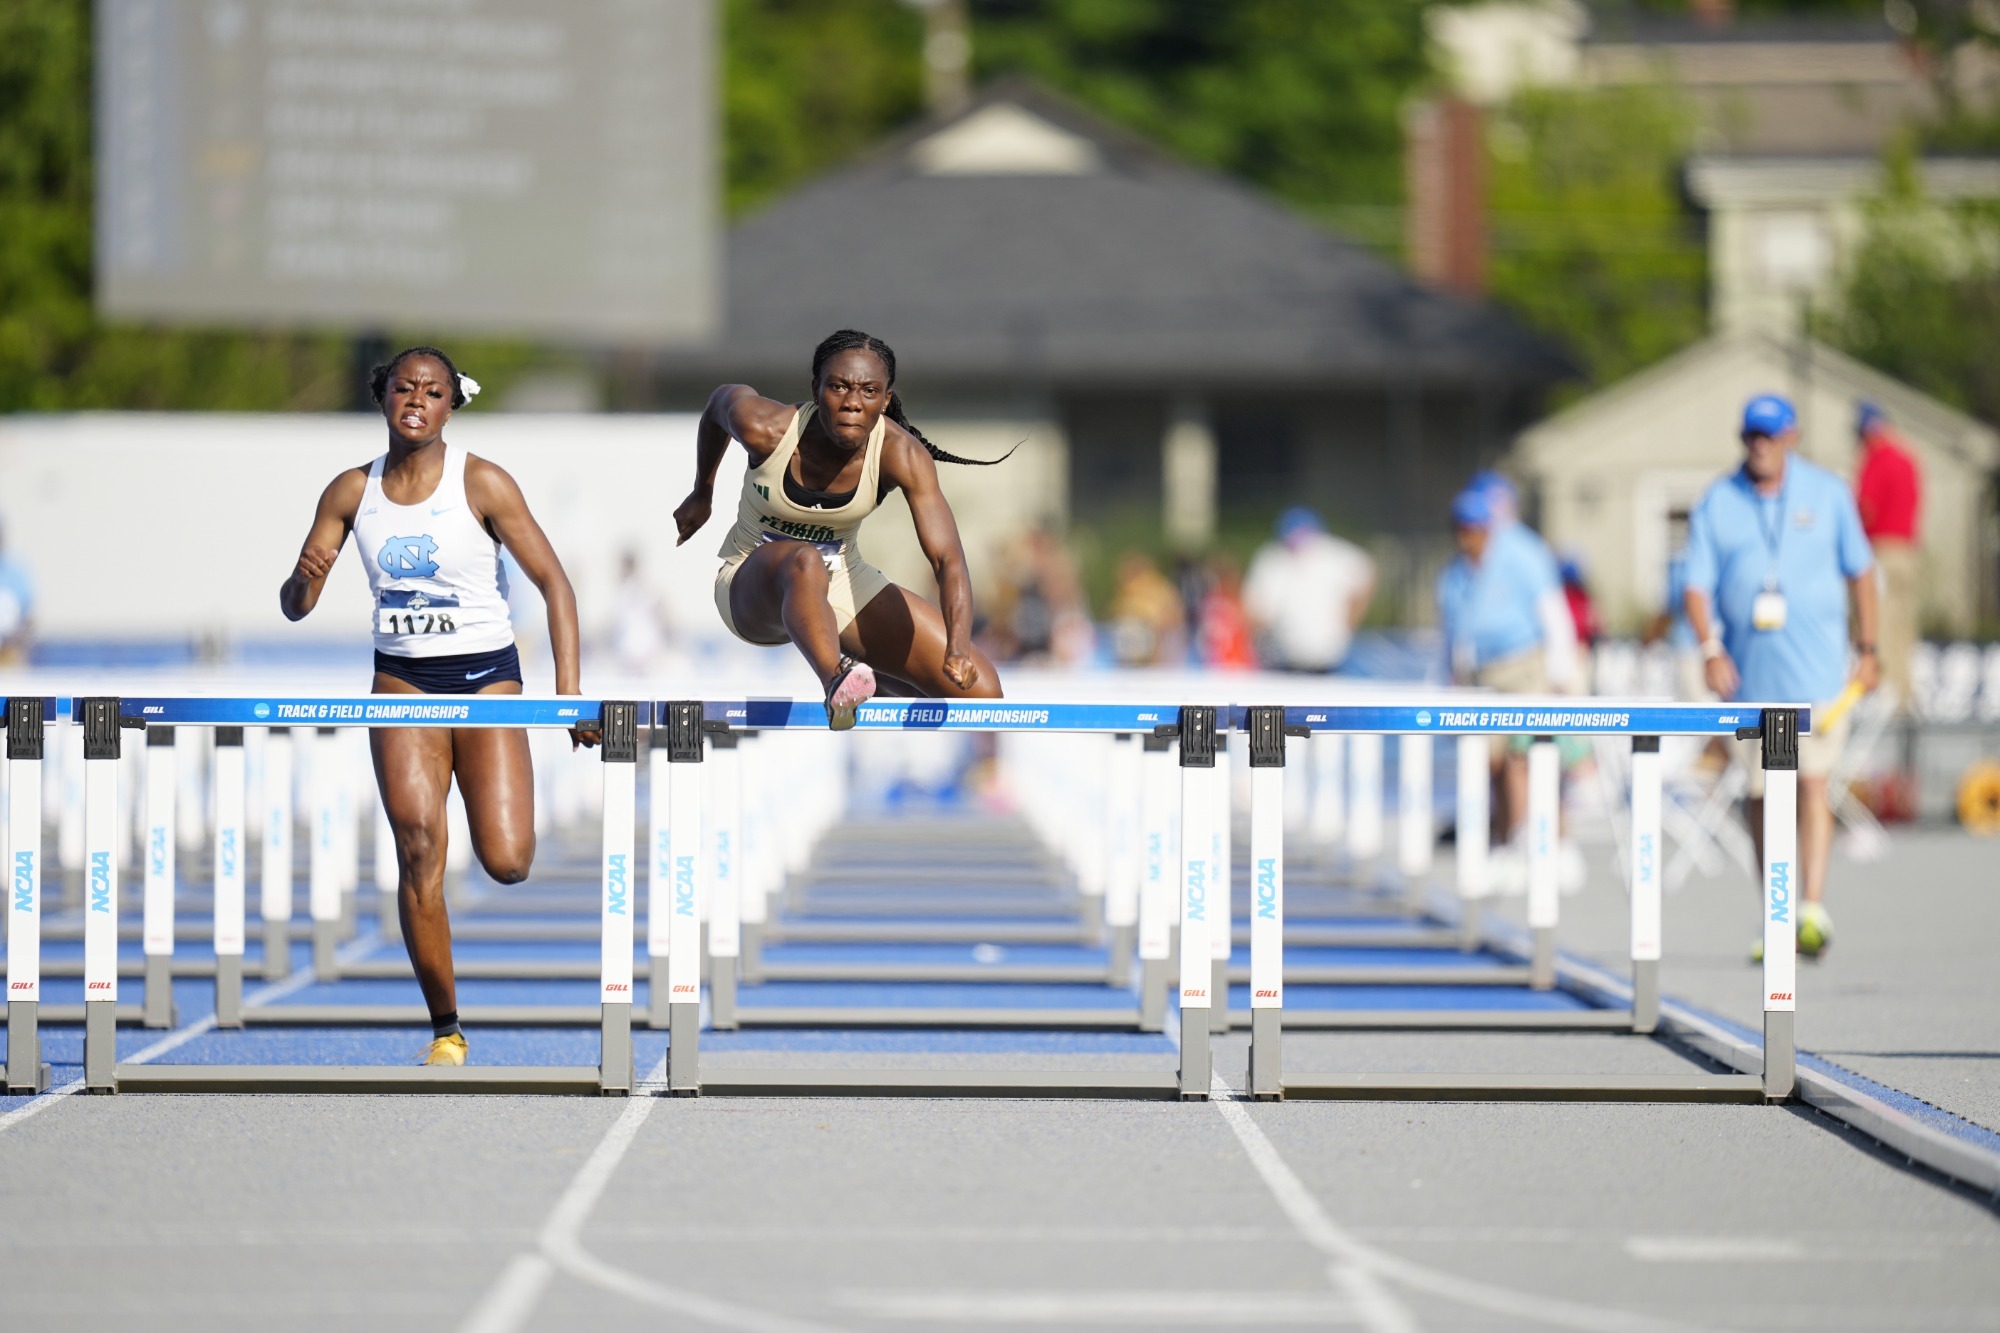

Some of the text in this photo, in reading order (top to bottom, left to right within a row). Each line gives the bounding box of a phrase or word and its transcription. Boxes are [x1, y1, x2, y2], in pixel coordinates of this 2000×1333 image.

[389, 613, 455, 634] 1128
[143, 706, 165, 714] GILL
[277, 704, 317, 718] TRACK
[318, 705, 327, 718] &
[329, 704, 362, 719] FIELD
[365, 704, 470, 719] CHAMPIONSHIPS
[557, 708, 580, 717] GILL
[725, 709, 748, 718] GILL
[859, 708, 1049, 724] TRACK & FIELD CHAMPIONSHIPS
[1137, 713, 1159, 721] GILL
[1305, 714, 1328, 723] GILL
[1439, 712, 1478, 726] TRACK
[1479, 713, 1488, 726] &
[1490, 712, 1524, 727] FIELD
[1526, 712, 1630, 727] CHAMPIONSHIPS
[1718, 716, 1740, 724] GILL
[608, 751, 633, 759] GILL
[674, 752, 698, 760] GILL
[15, 851, 34, 913] NCAA
[92, 851, 110, 913] NCAA
[608, 854, 626, 916] NCAA
[676, 856, 694, 917] NCAA
[1188, 860, 1206, 921] NCAA
[1258, 858, 1276, 920] NCAA
[1771, 862, 1789, 923] NCAA
[11, 981, 35, 990] GILL
[88, 981, 112, 990] GILL
[605, 983, 629, 992] GILL
[672, 984, 696, 993] GILL
[1183, 989, 1207, 997] GILL
[1255, 990, 1278, 998] GILL
[1769, 992, 1793, 1001] GILL
